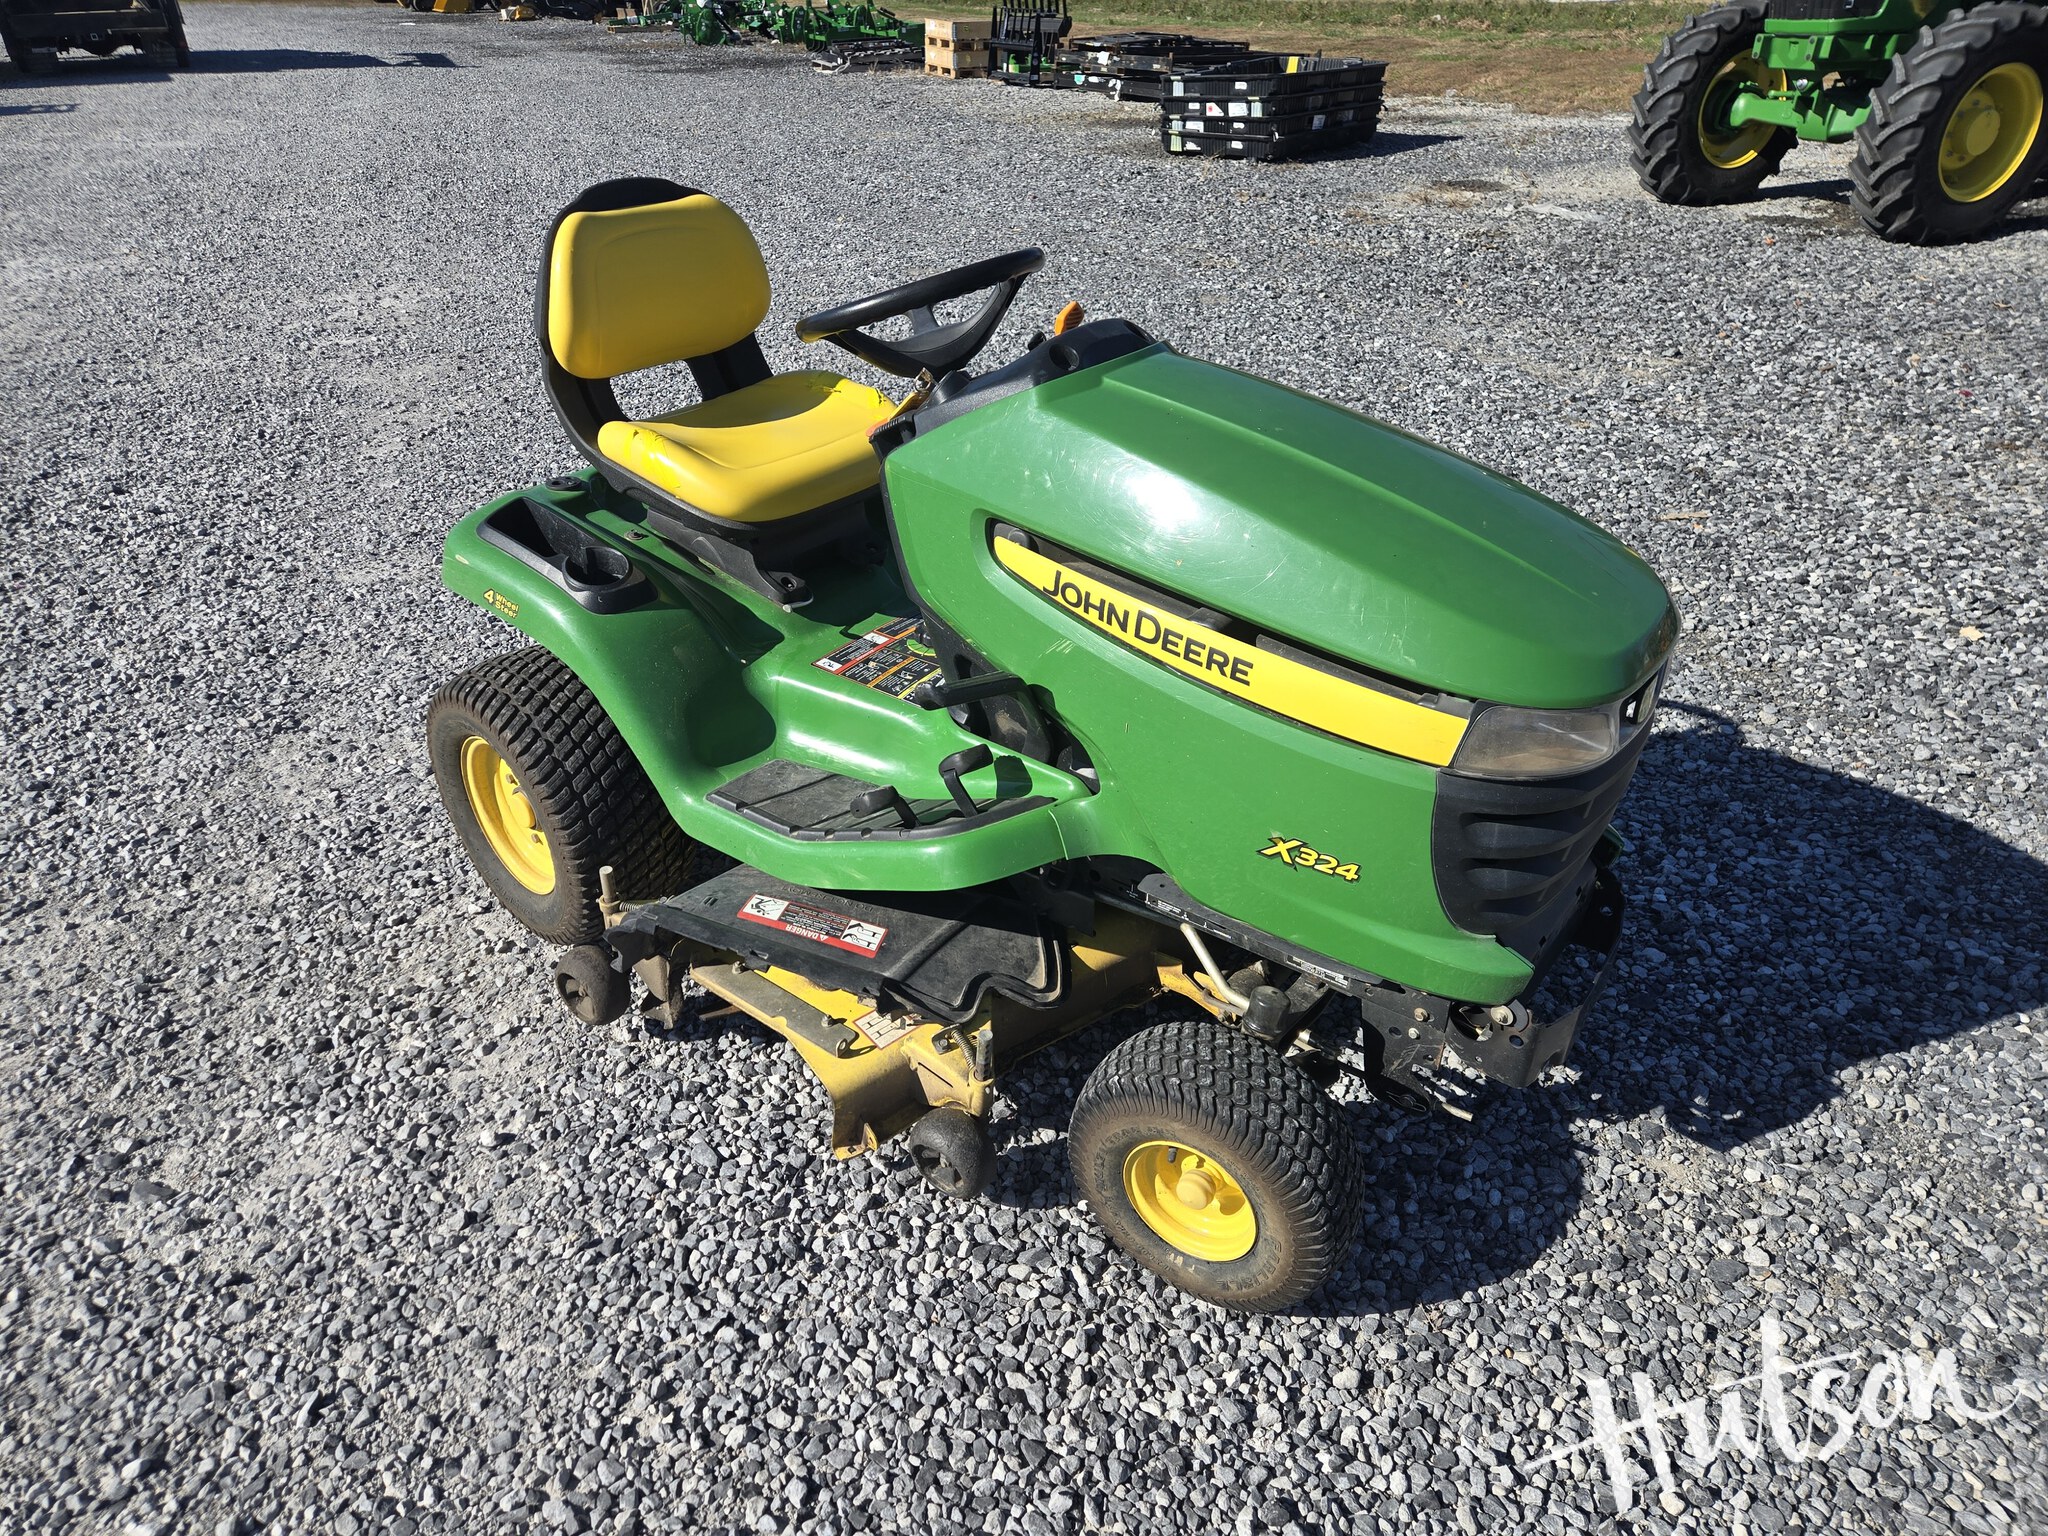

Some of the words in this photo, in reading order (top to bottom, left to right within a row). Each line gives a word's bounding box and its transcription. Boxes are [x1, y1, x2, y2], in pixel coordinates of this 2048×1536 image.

[483, 589, 495, 605] 4
[496, 592, 519, 612] Wheel
[495, 601, 518, 619] Steer
[1042, 570, 1129, 634] JOHN
[1134, 609, 1254, 687] DEERE
[1257, 836, 1361, 883] X324
[785, 924, 819, 940] DANGER
